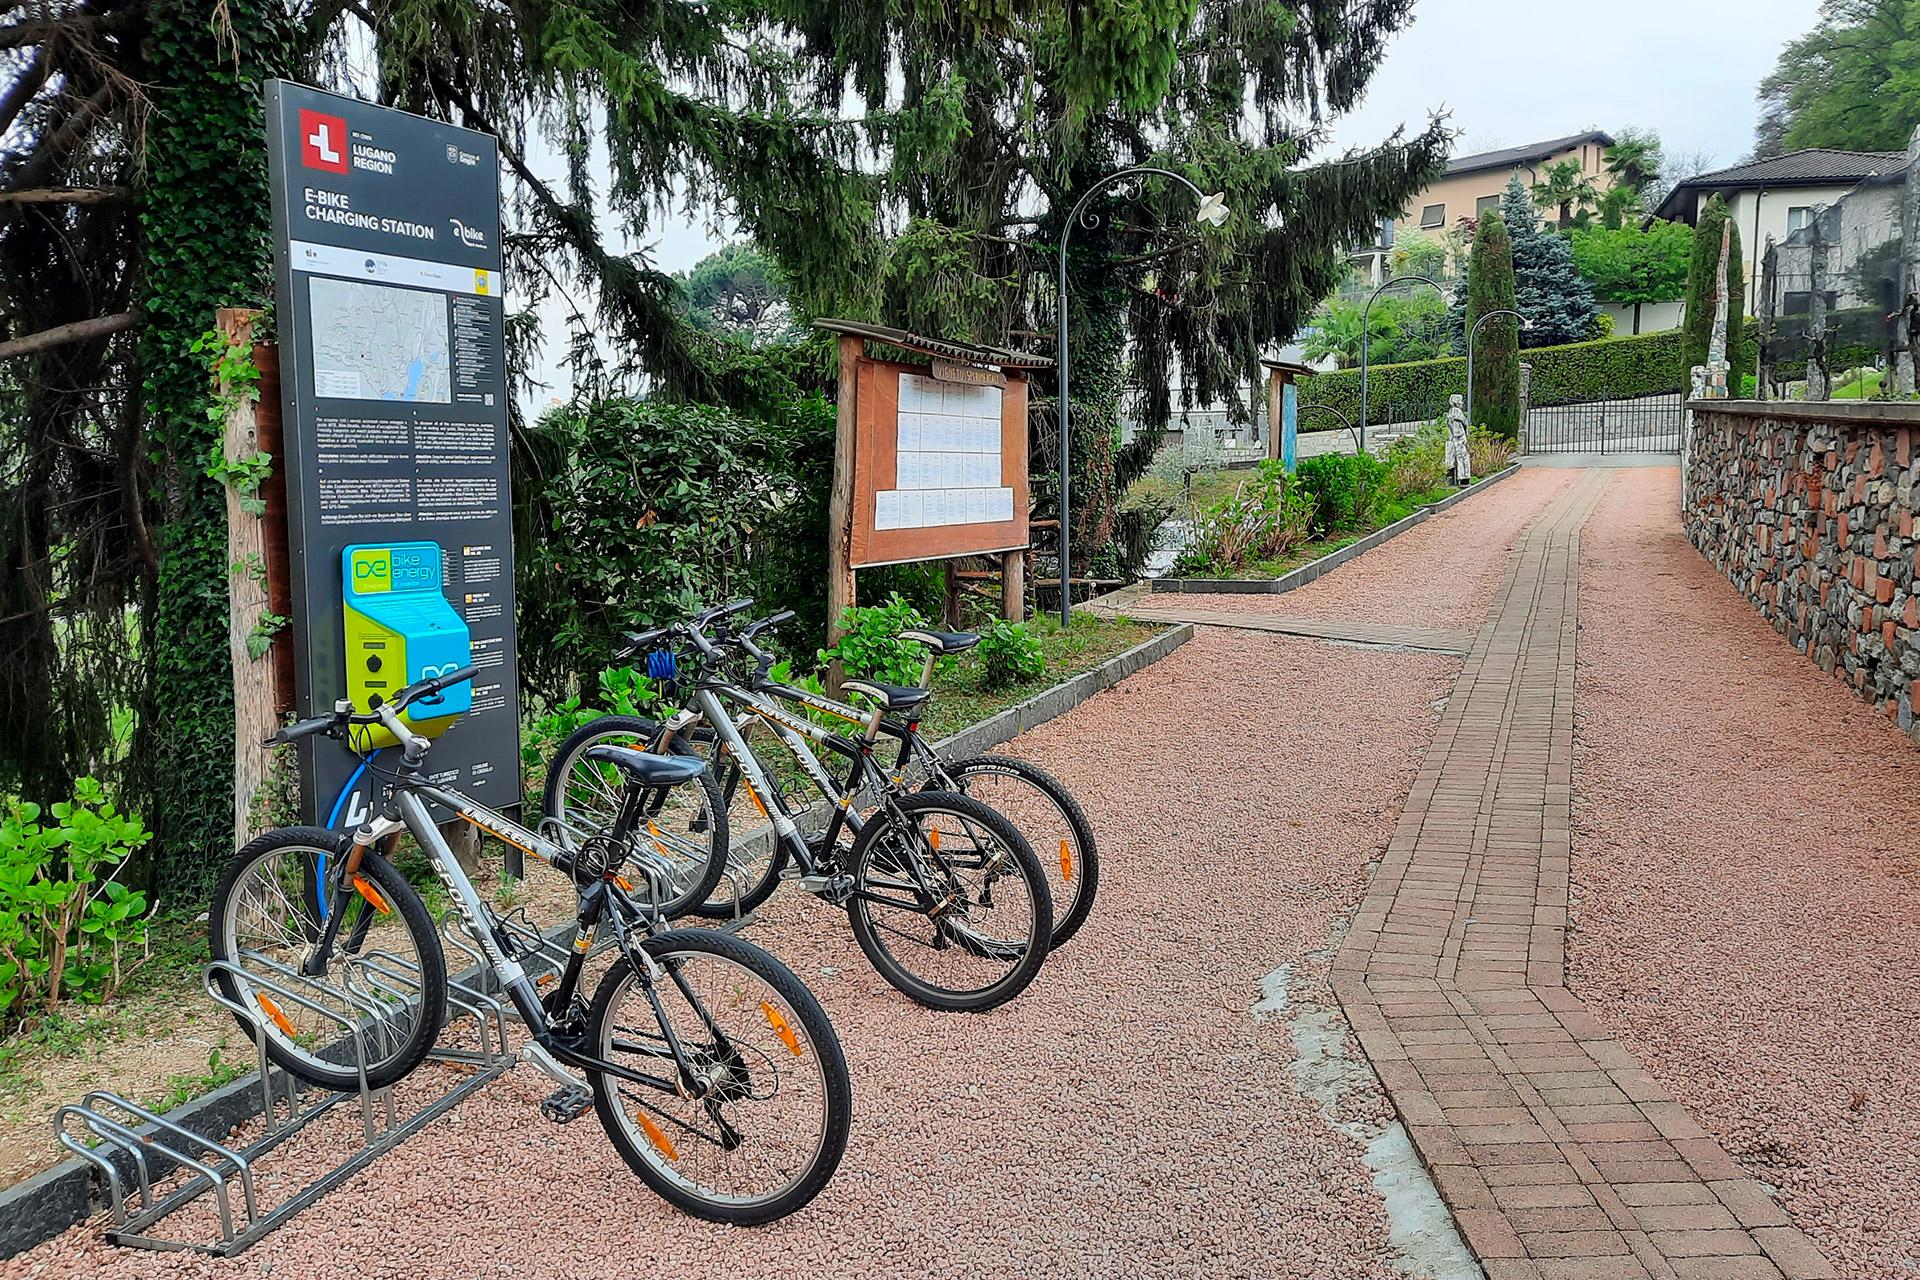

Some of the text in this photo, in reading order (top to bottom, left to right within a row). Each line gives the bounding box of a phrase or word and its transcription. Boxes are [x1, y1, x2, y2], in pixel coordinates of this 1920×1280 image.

[352, 143, 396, 163] LUGANO
[353, 156, 392, 175] REGION
[304, 187, 349, 209] E-BIKE
[305, 204, 434, 240] CHARGING STATION
[392, 553, 420, 567] bike
[392, 567, 436, 579] energy
[752, 700, 811, 736] UNIVEGA
[727, 740, 767, 797] SPORT
[782, 734, 823, 782] SPORT
[462, 806, 534, 851] UNIVEGA
[430, 857, 483, 932] SPORT
